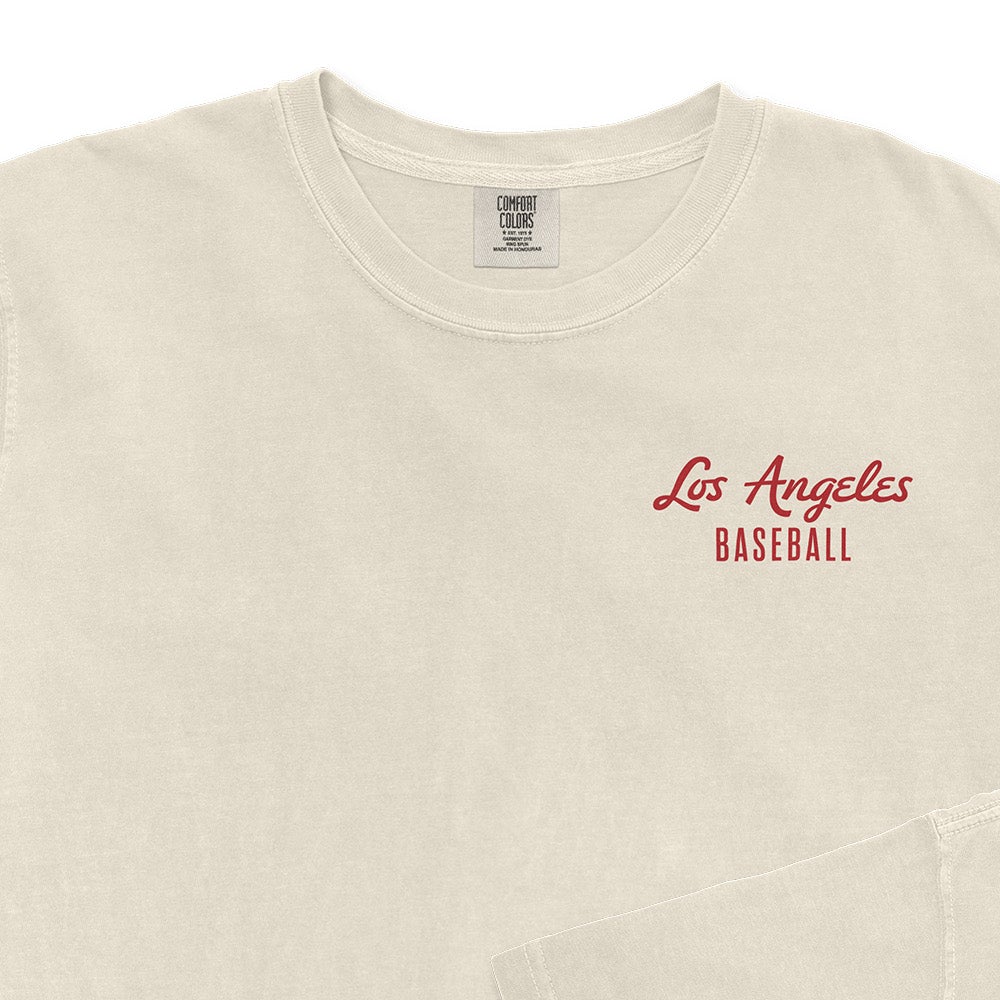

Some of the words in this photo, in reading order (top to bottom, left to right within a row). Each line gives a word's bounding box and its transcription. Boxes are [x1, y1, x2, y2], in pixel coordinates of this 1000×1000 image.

[497, 195, 538, 212] COMFORT
[499, 212, 534, 229] COLORS
[652, 456, 728, 512] Los
[744, 454, 913, 523] Angeles
[715, 527, 851, 562] BASEBALL
